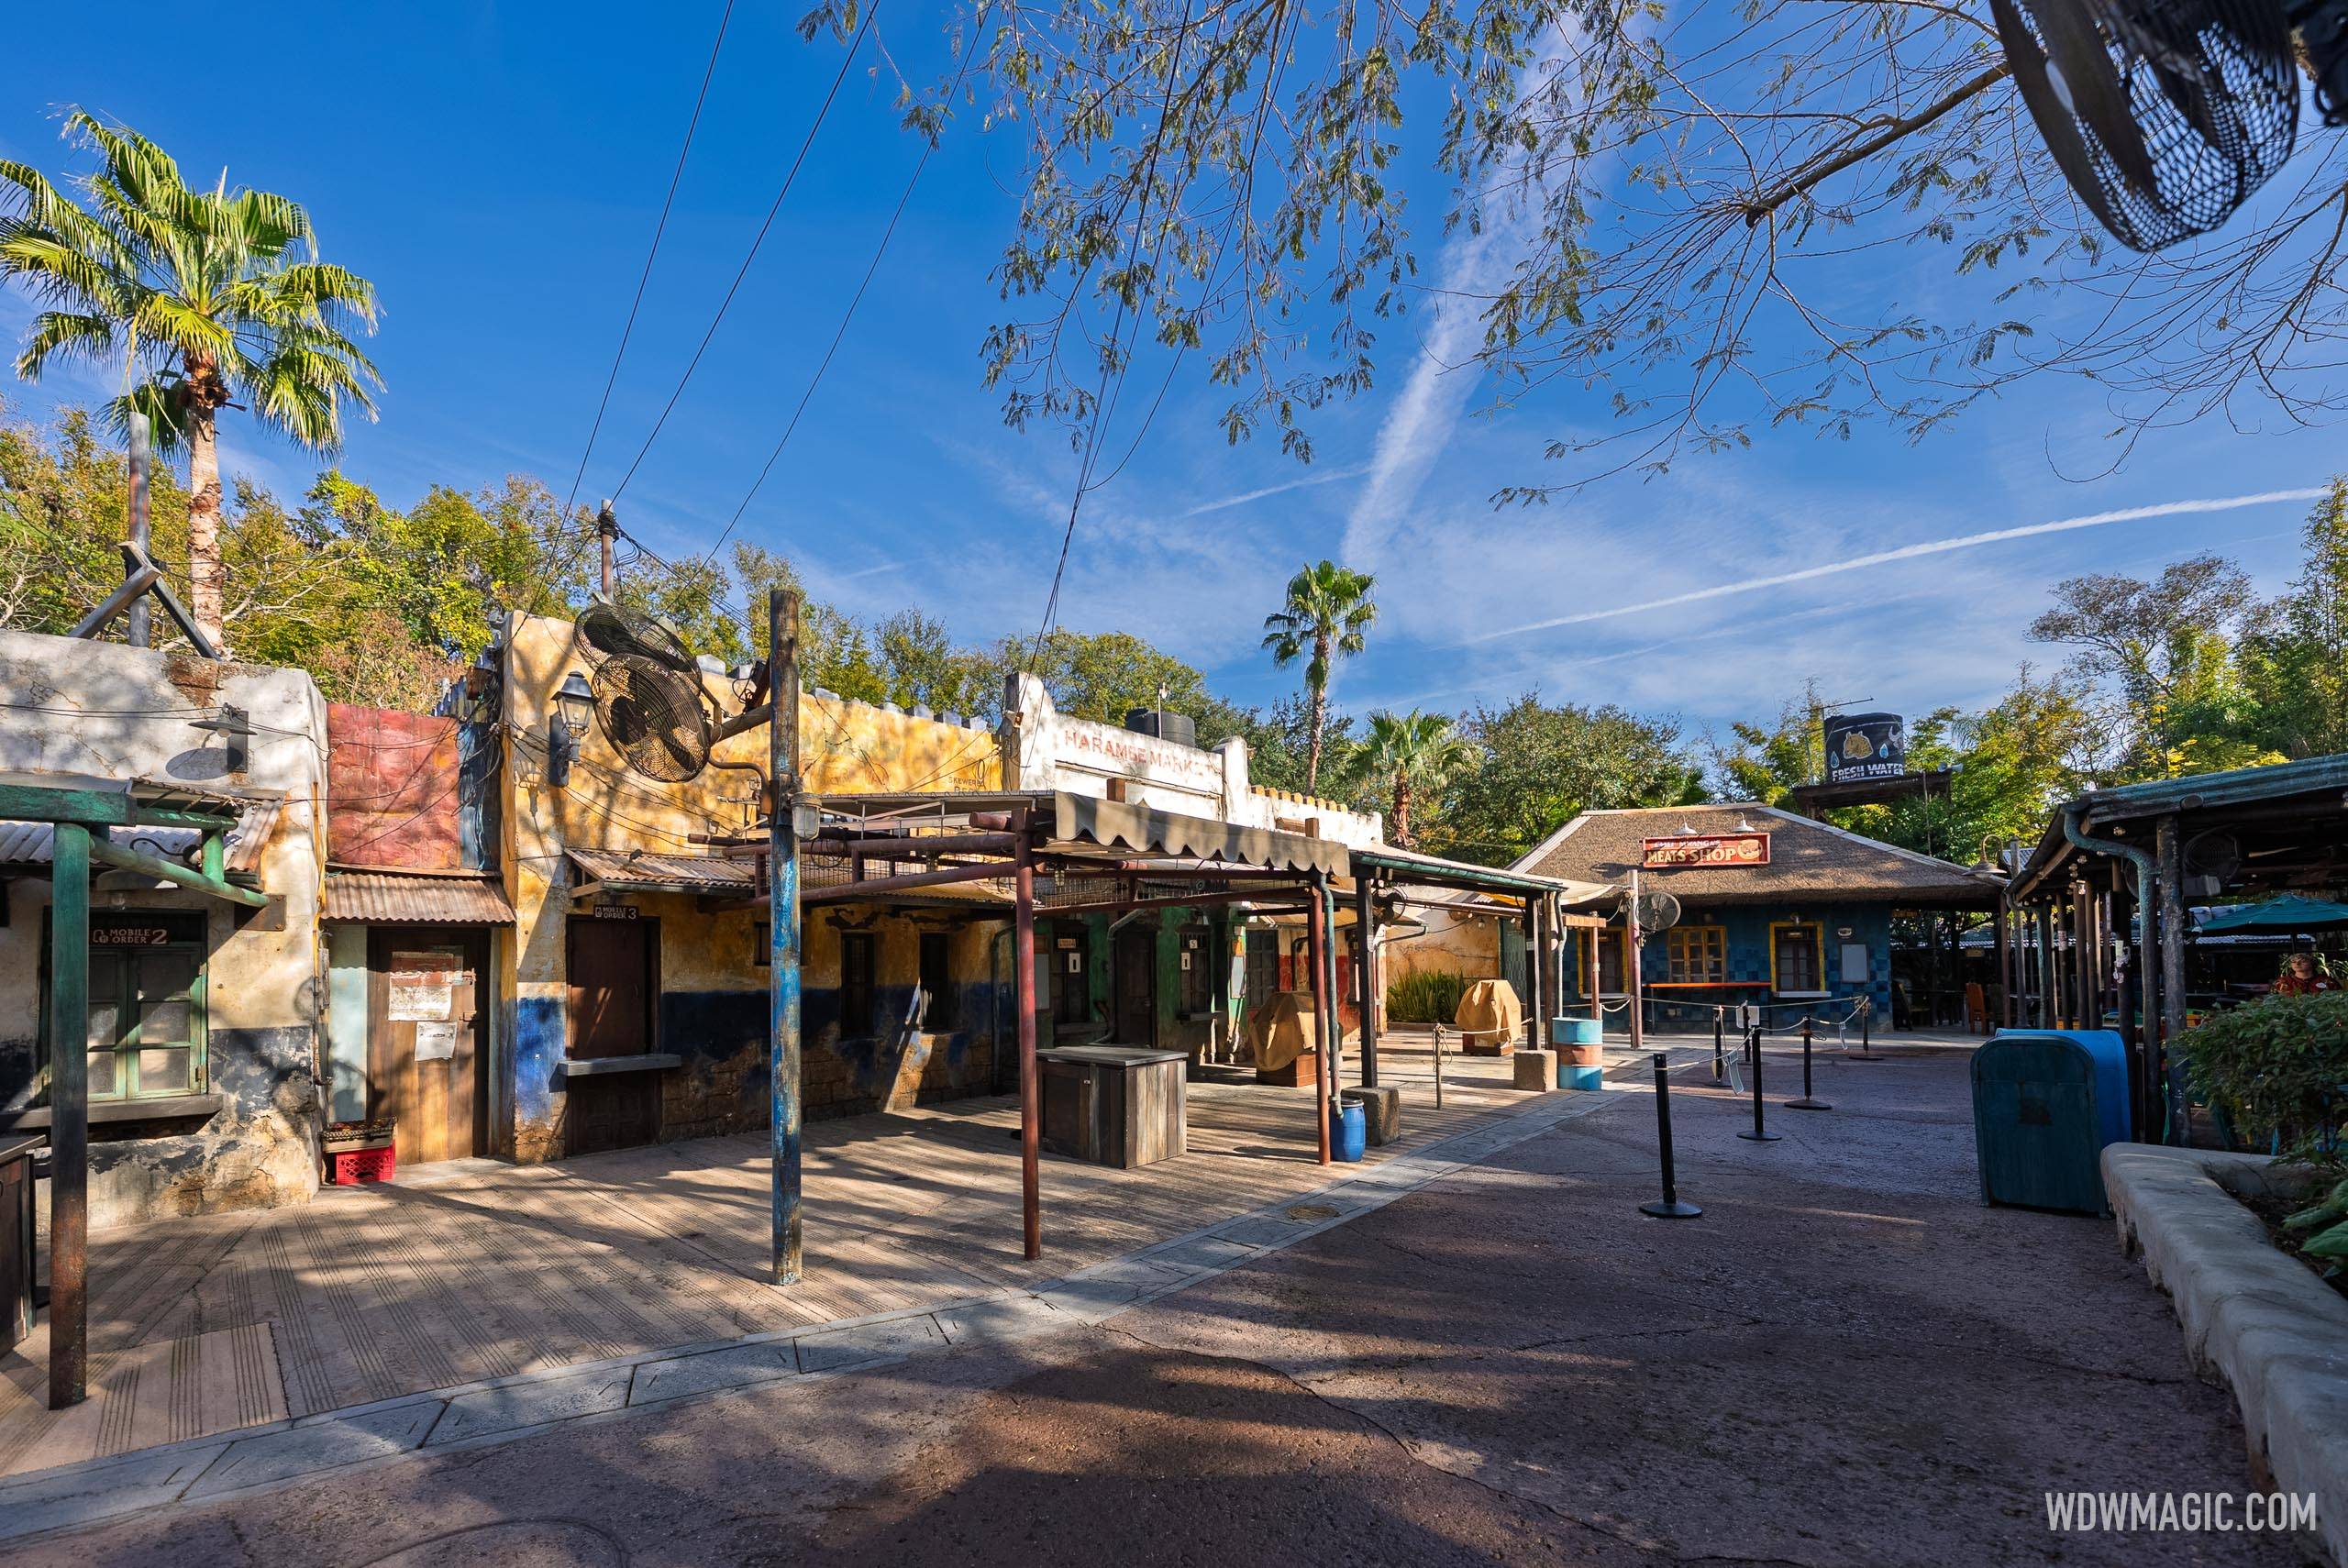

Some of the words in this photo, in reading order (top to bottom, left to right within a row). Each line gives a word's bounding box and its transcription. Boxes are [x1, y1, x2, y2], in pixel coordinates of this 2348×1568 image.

[1064, 730, 1146, 764] HARAMBE
[1832, 765, 1865, 782] FRESH
[1866, 763, 1904, 776] WATER
[1647, 849, 1686, 863] MEATS
[1689, 847, 1737, 862] SHOP
[628, 908, 637, 920] 3
[109, 928, 151, 936] MOBILE
[112, 935, 147, 944] ORDER
[150, 929, 167, 944] 2
